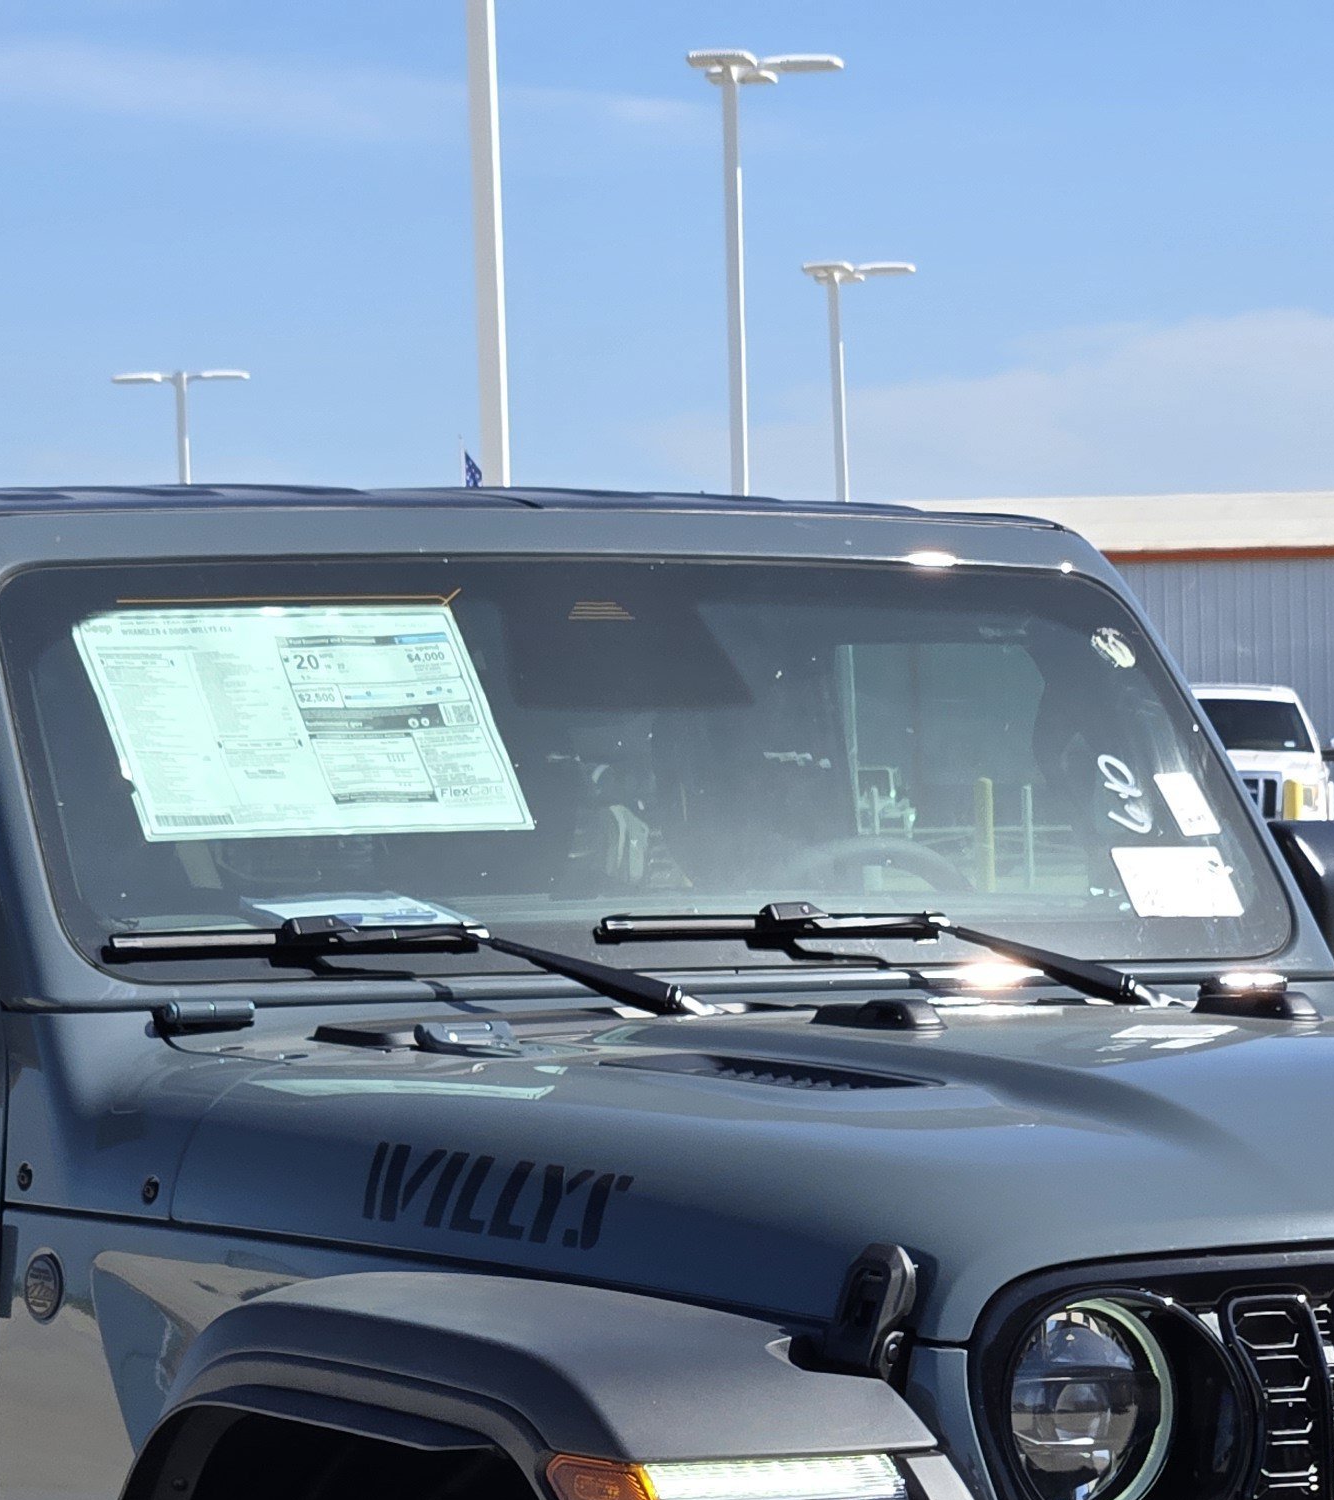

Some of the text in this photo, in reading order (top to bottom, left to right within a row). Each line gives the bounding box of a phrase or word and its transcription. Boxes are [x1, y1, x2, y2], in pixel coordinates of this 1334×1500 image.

[293, 653, 320, 670] 20
[406, 651, 445, 663] $4,000
[440, 785, 503, 798] FlexCare
[362, 1141, 634, 1250] WILLYS
